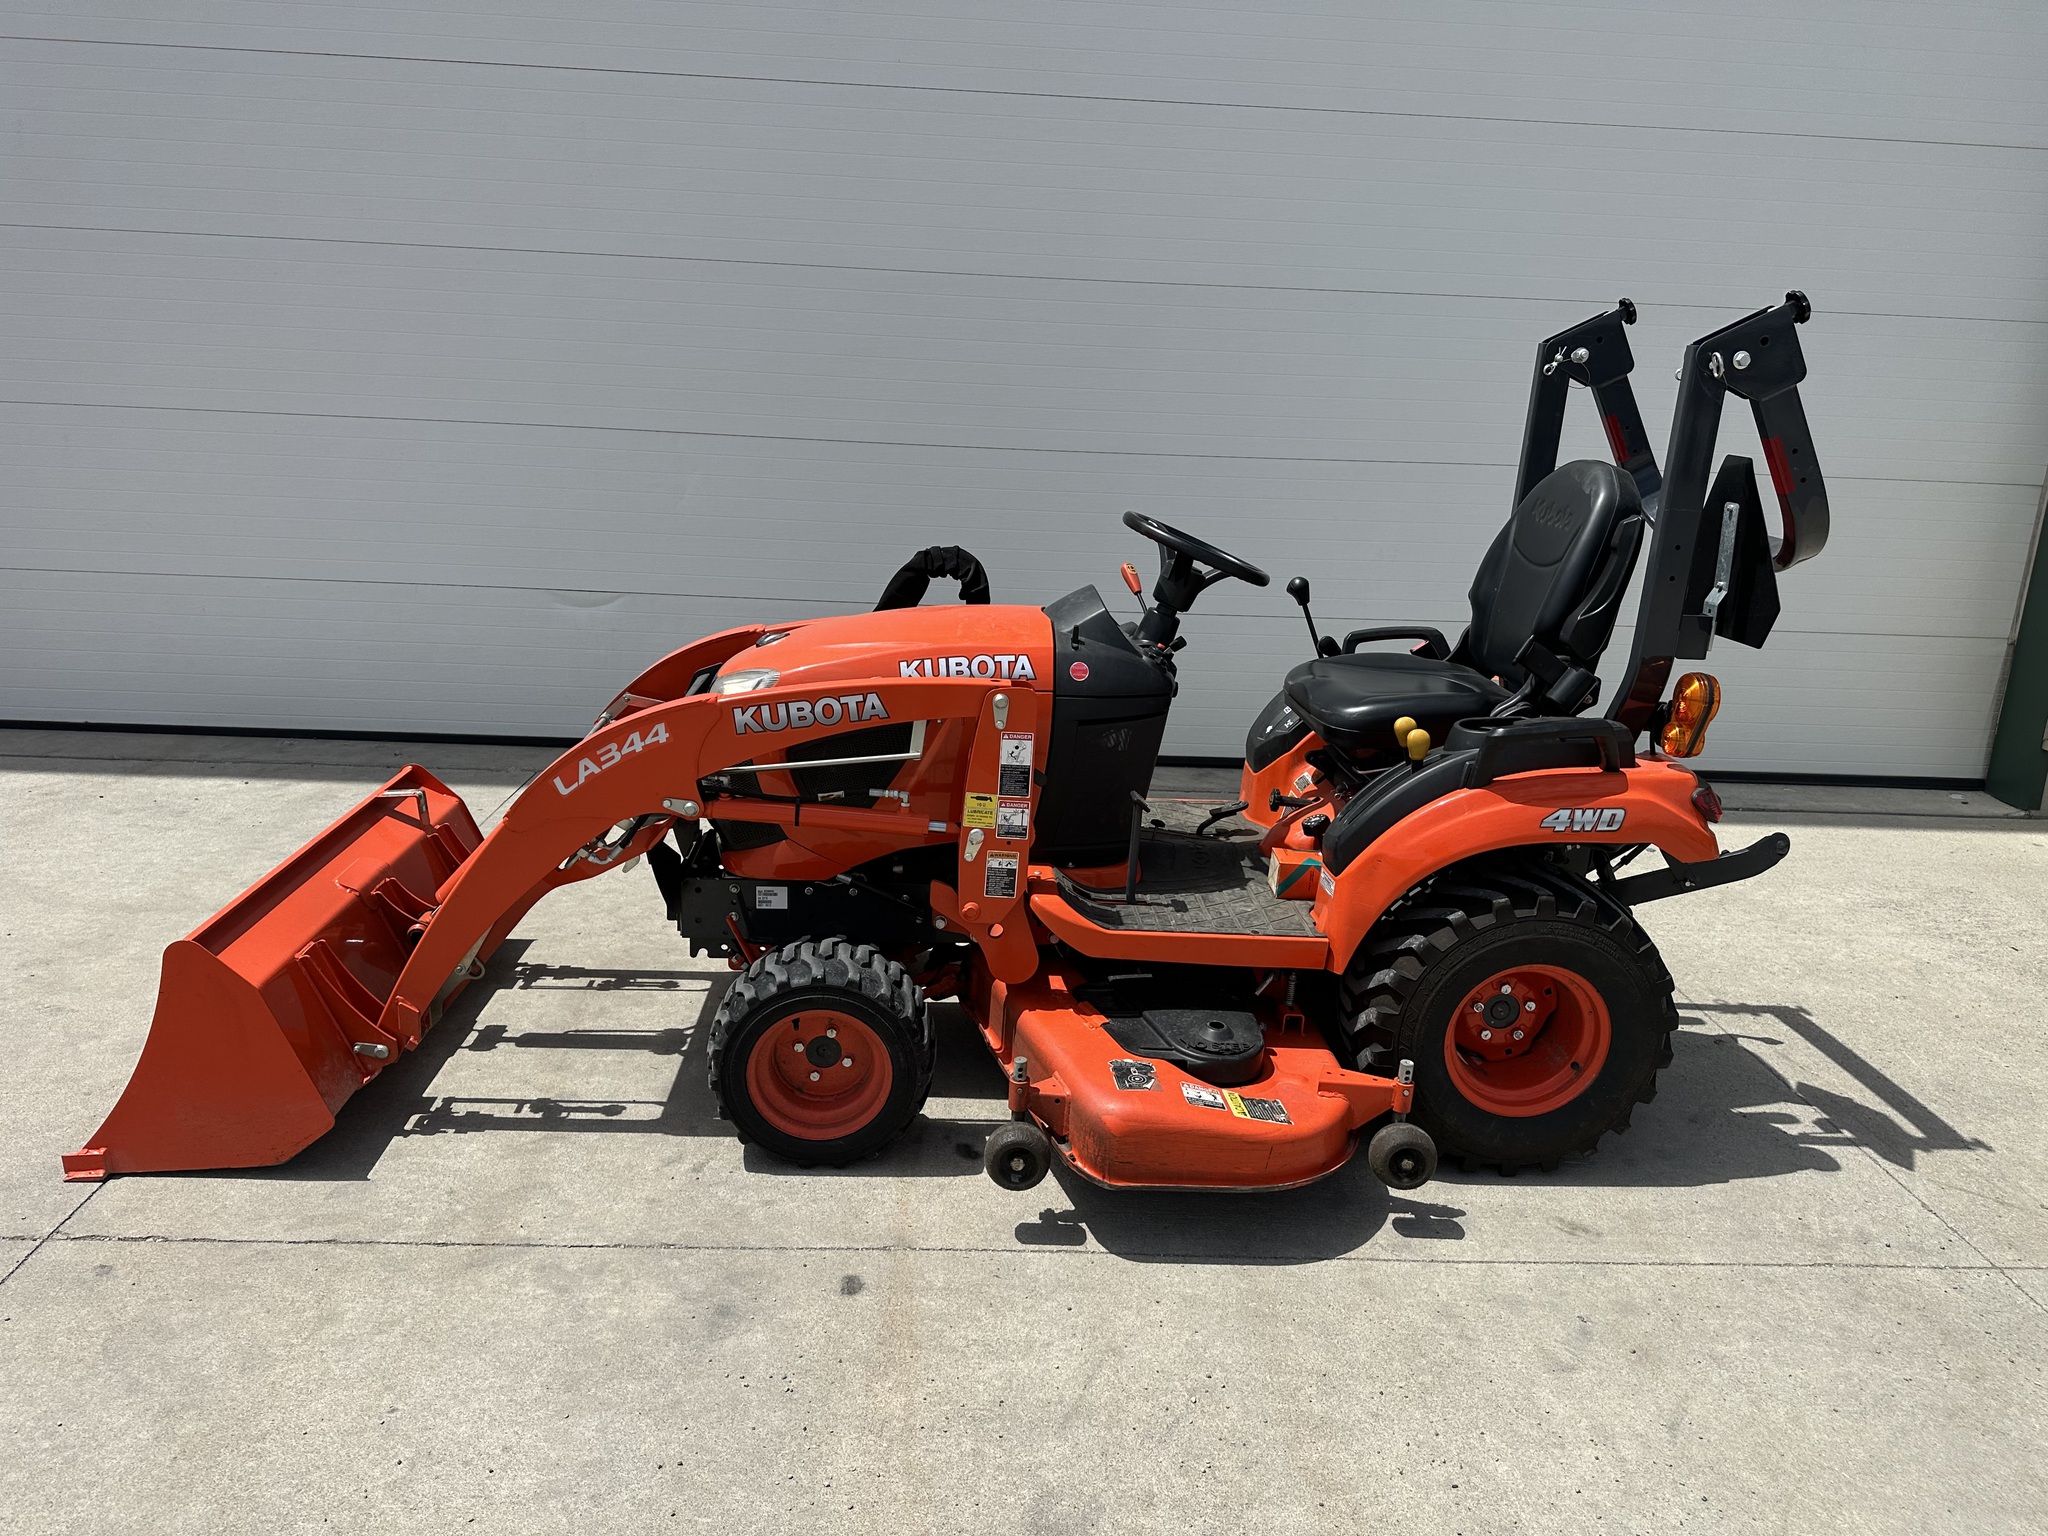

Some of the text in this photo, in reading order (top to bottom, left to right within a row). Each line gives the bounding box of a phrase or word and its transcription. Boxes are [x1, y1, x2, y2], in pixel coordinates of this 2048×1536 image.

[898, 654, 1037, 681] KUBOTA
[732, 692, 890, 735] KUBOTA
[552, 722, 670, 796] LA344
[1540, 807, 1627, 832] 4WD
